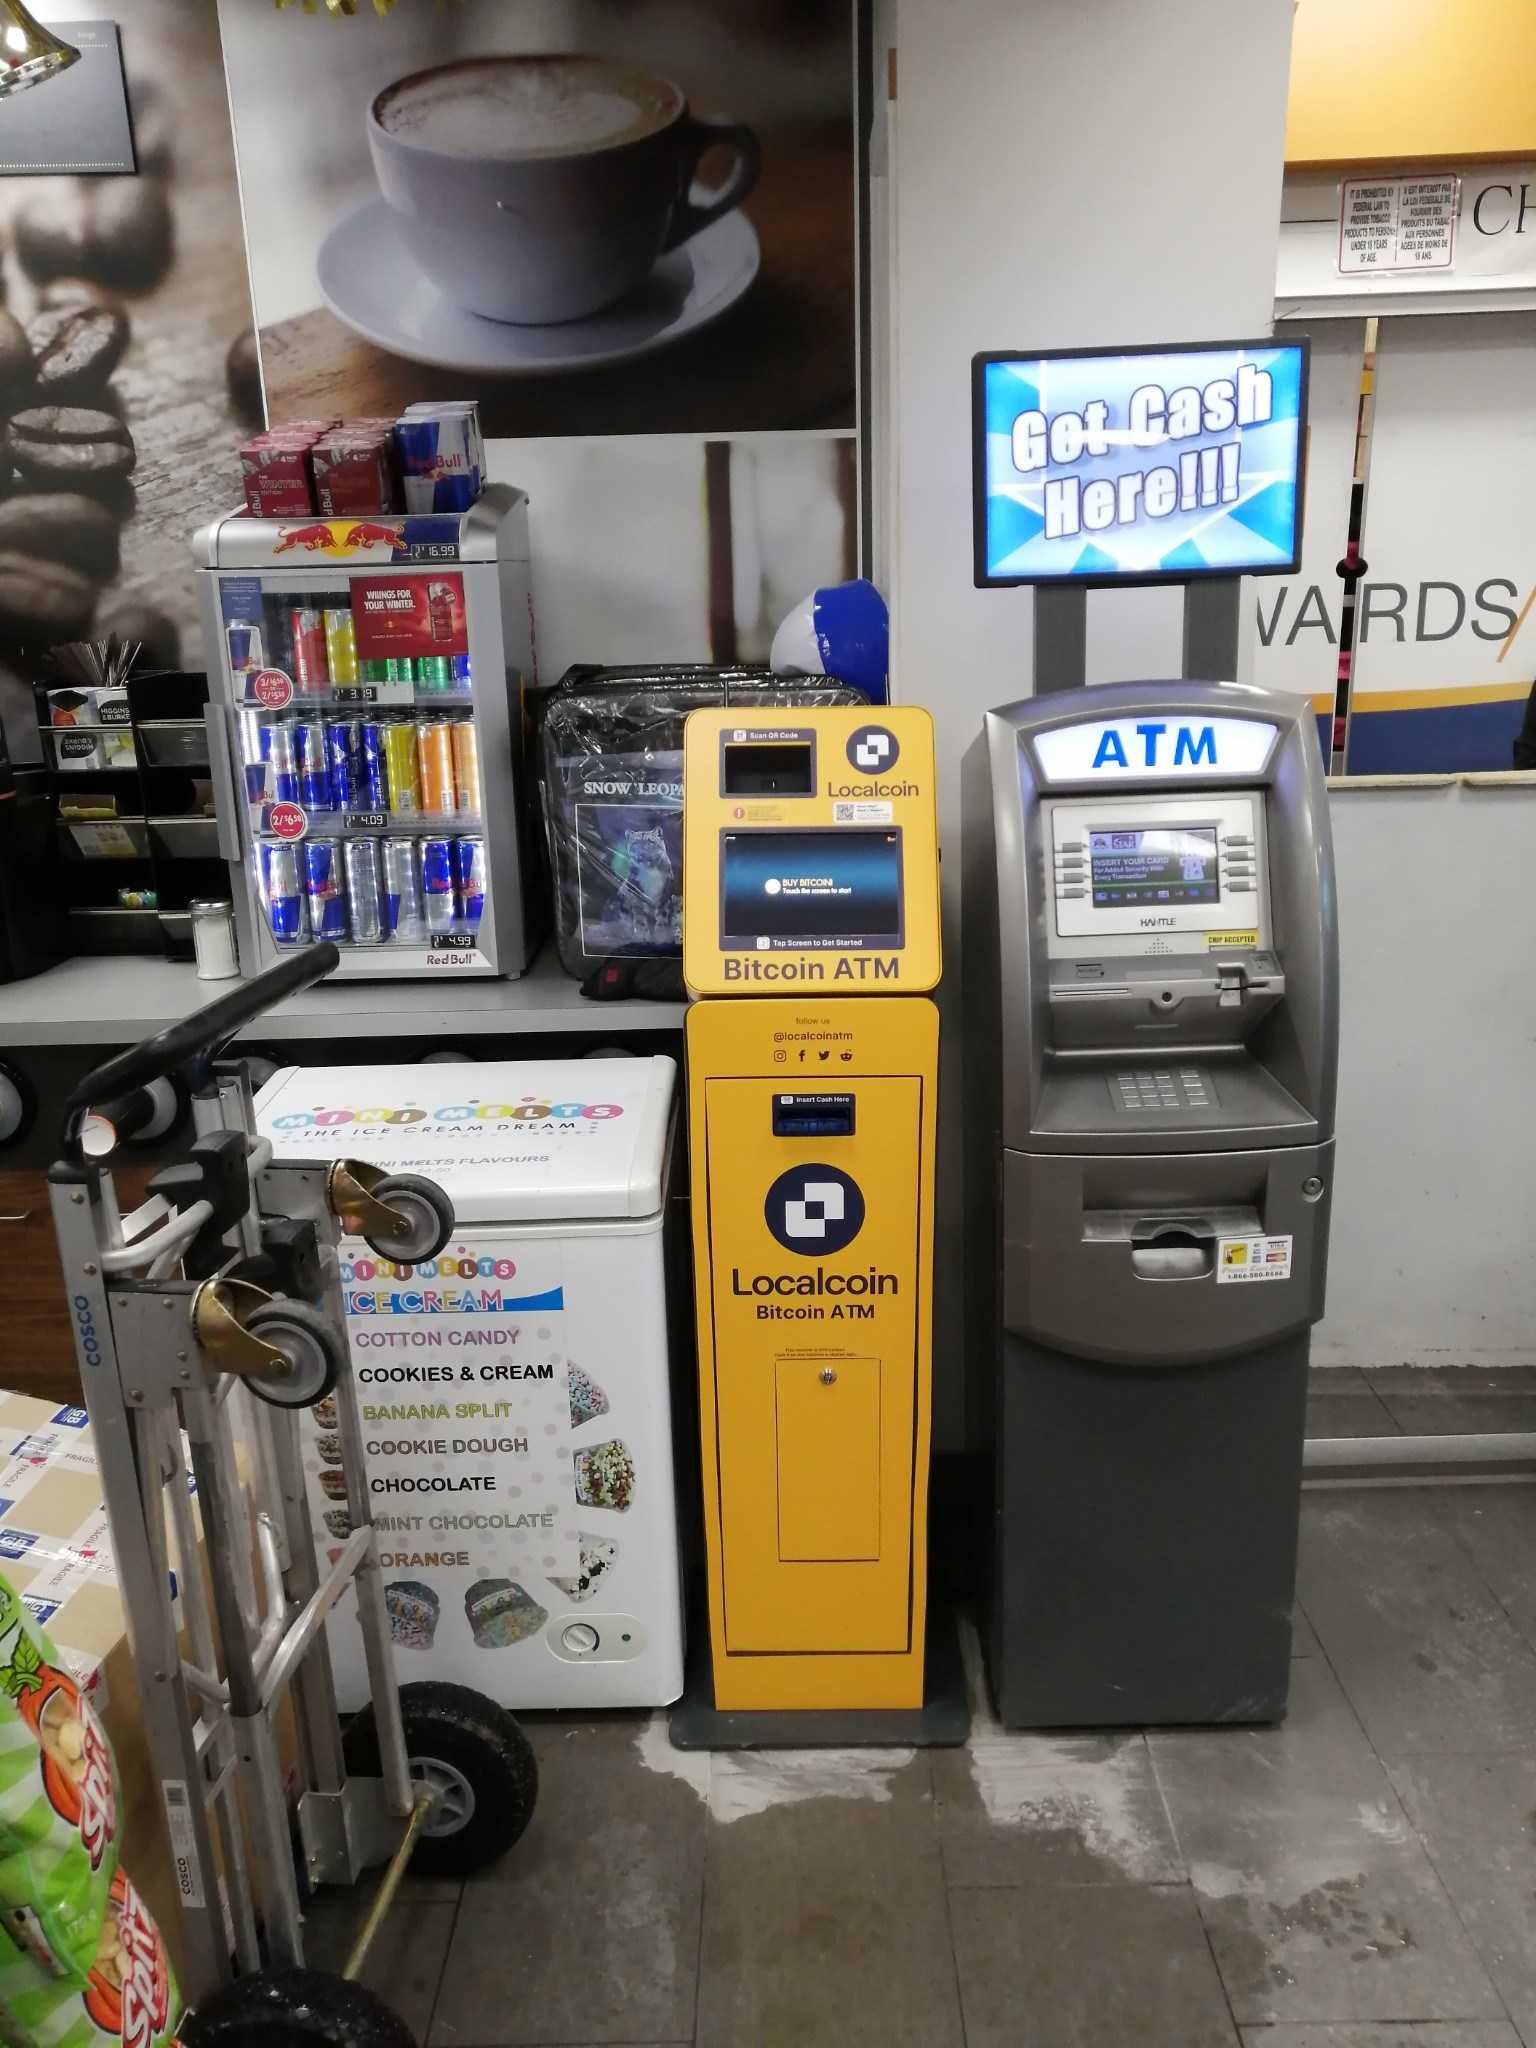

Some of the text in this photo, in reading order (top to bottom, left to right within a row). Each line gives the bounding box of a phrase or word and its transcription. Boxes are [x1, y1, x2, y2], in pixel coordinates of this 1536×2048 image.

[1011, 363, 1273, 473] Get Cash
[1044, 441, 1242, 540] Here!!!
[396, 589, 412, 599] FOR
[363, 599, 416, 610] YOUR WINTER.
[750, 732, 798, 740] Scan QR Code
[1092, 723, 1218, 769] ATM
[584, 781, 630, 795] SNOW
[827, 781, 920, 798] Localcoin
[361, 815, 383, 826] 4.09
[1093, 856, 1169, 866] INSERT YOUR CARD
[782, 879, 798, 887] BUY
[449, 935, 471, 946] 4.99
[772, 938, 863, 948] Tap Screen to Get Started
[427, 955, 449, 965] Red
[723, 957, 900, 981] Bitcoin ATM
[796, 1017, 819, 1025] follow
[773, 1031, 853, 1043] @localcoinatm
[278, 1104, 616, 1129] MINI MELTS
[404, 1125, 484, 1134] CREAM
[497, 1122, 576, 1131] DREAM
[400, 1157, 453, 1167] MELTS
[458, 1154, 551, 1165] FLAVOURS
[419, 1259, 512, 1278] MELTS
[731, 1266, 899, 1296] Localcoin
[398, 1288, 505, 1313] CREAM
[756, 1304, 875, 1320] Bitcoin ATM
[75, 1295, 101, 1367] COSCO
[355, 1329, 520, 1348] COTTON CANDY
[358, 1364, 554, 1384] COOKIES & CREAM
[362, 1402, 513, 1421] BANANA SPLIT
[366, 1437, 529, 1456] COOKIE DOUGH
[370, 1476, 497, 1493] CHOCOLATE
[373, 1513, 554, 1532] MINT CHOCOLATE
[379, 1551, 471, 1568] ORANGE
[177, 1857, 191, 1895] COSCO
